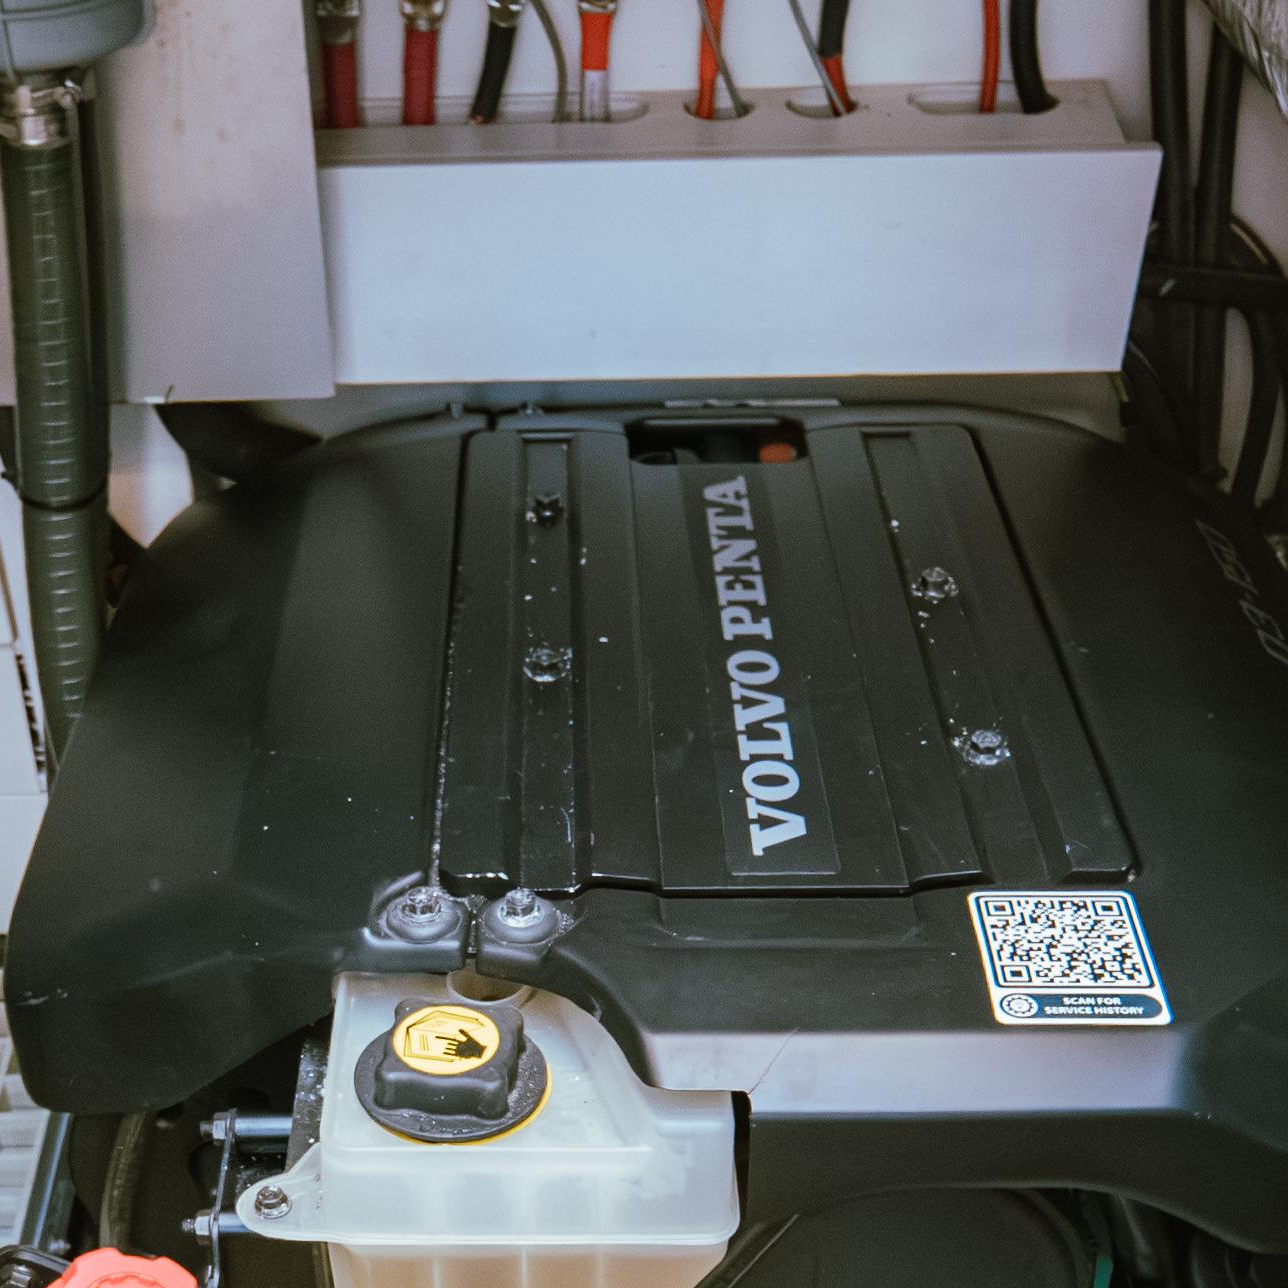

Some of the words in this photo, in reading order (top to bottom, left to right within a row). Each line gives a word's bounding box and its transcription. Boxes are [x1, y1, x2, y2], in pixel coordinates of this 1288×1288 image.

[703, 474, 773, 641] PENTA
[726, 649, 807, 857] VOLVO
[1044, 1006, 1093, 1015] SERVICE
[1094, 1006, 1144, 1016] HISTORY
[1063, 996, 1096, 1006] SCAN
[1097, 996, 1122, 1006] FOR
